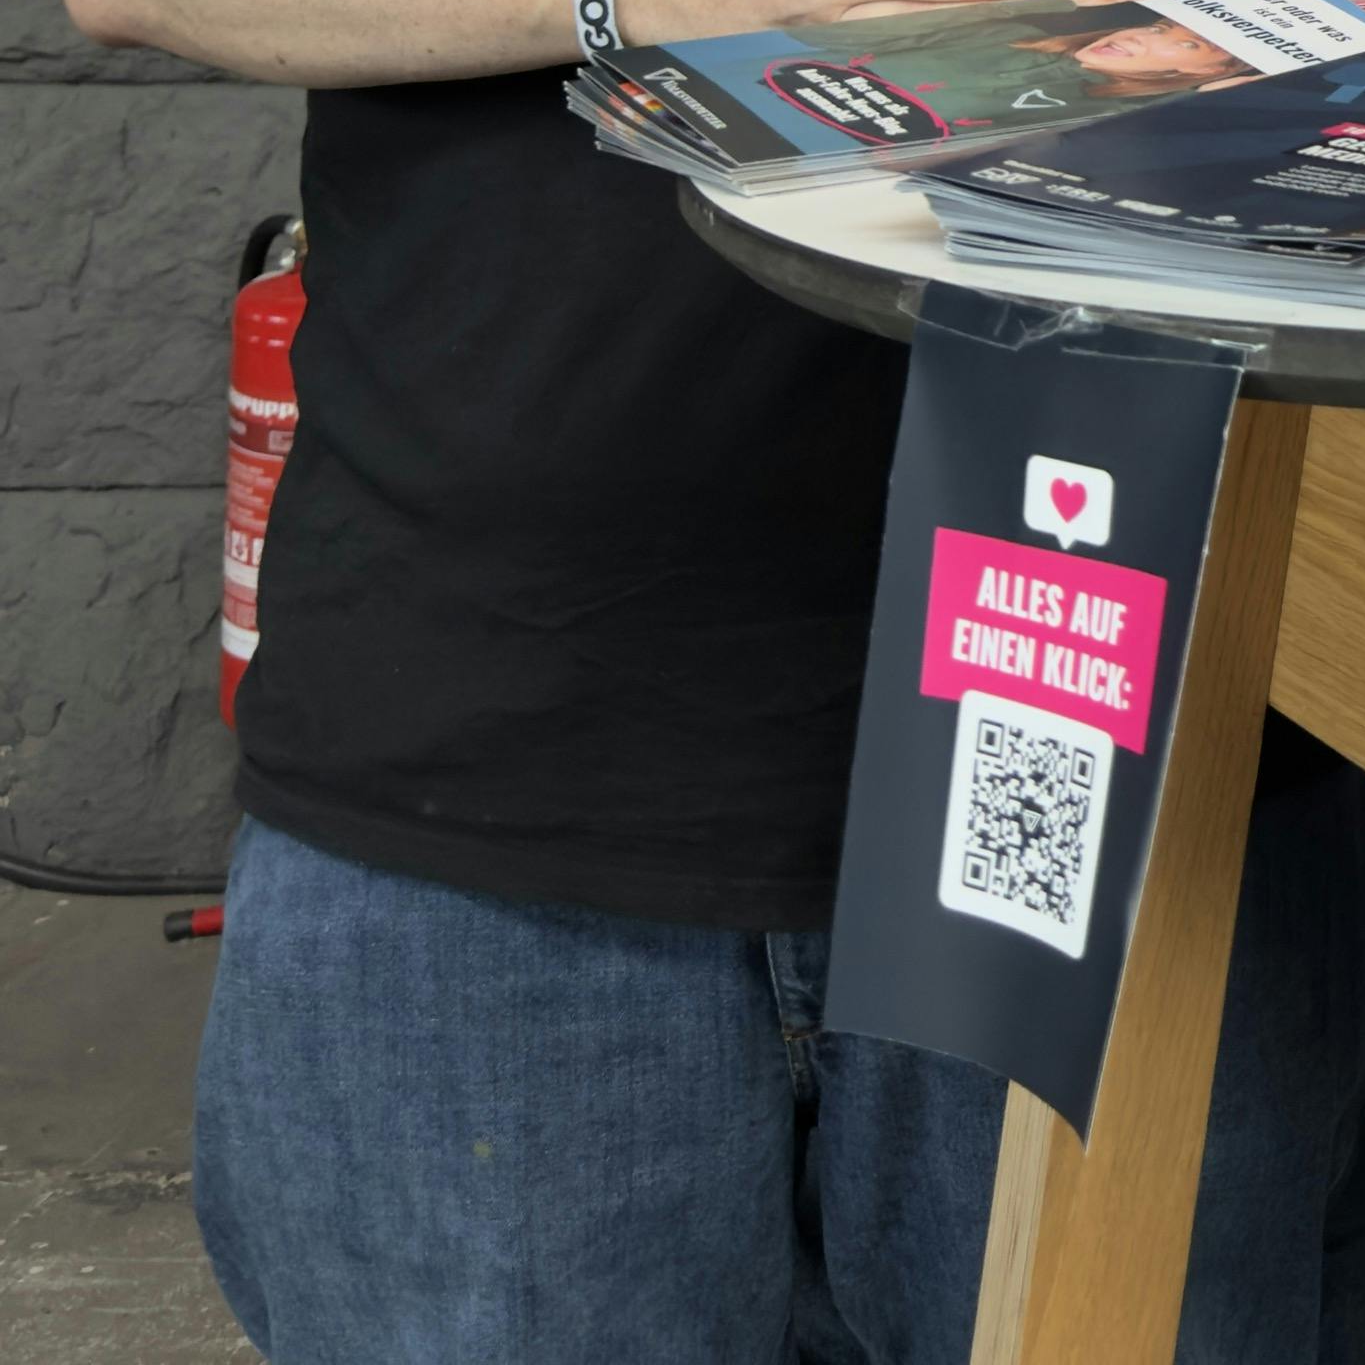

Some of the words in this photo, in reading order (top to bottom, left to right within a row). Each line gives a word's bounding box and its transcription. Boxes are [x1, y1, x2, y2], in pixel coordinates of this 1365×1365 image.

[1253, 7, 1278, 19] ist
[1270, 15, 1296, 30] ein
[1282, 4, 1323, 25] oder
[1318, 24, 1352, 44] was
[976, 566, 1065, 629] ALLES
[1069, 591, 1128, 646] AUF
[951, 617, 1036, 693] EINEN
[1041, 643, 1132, 712] KLICK:
